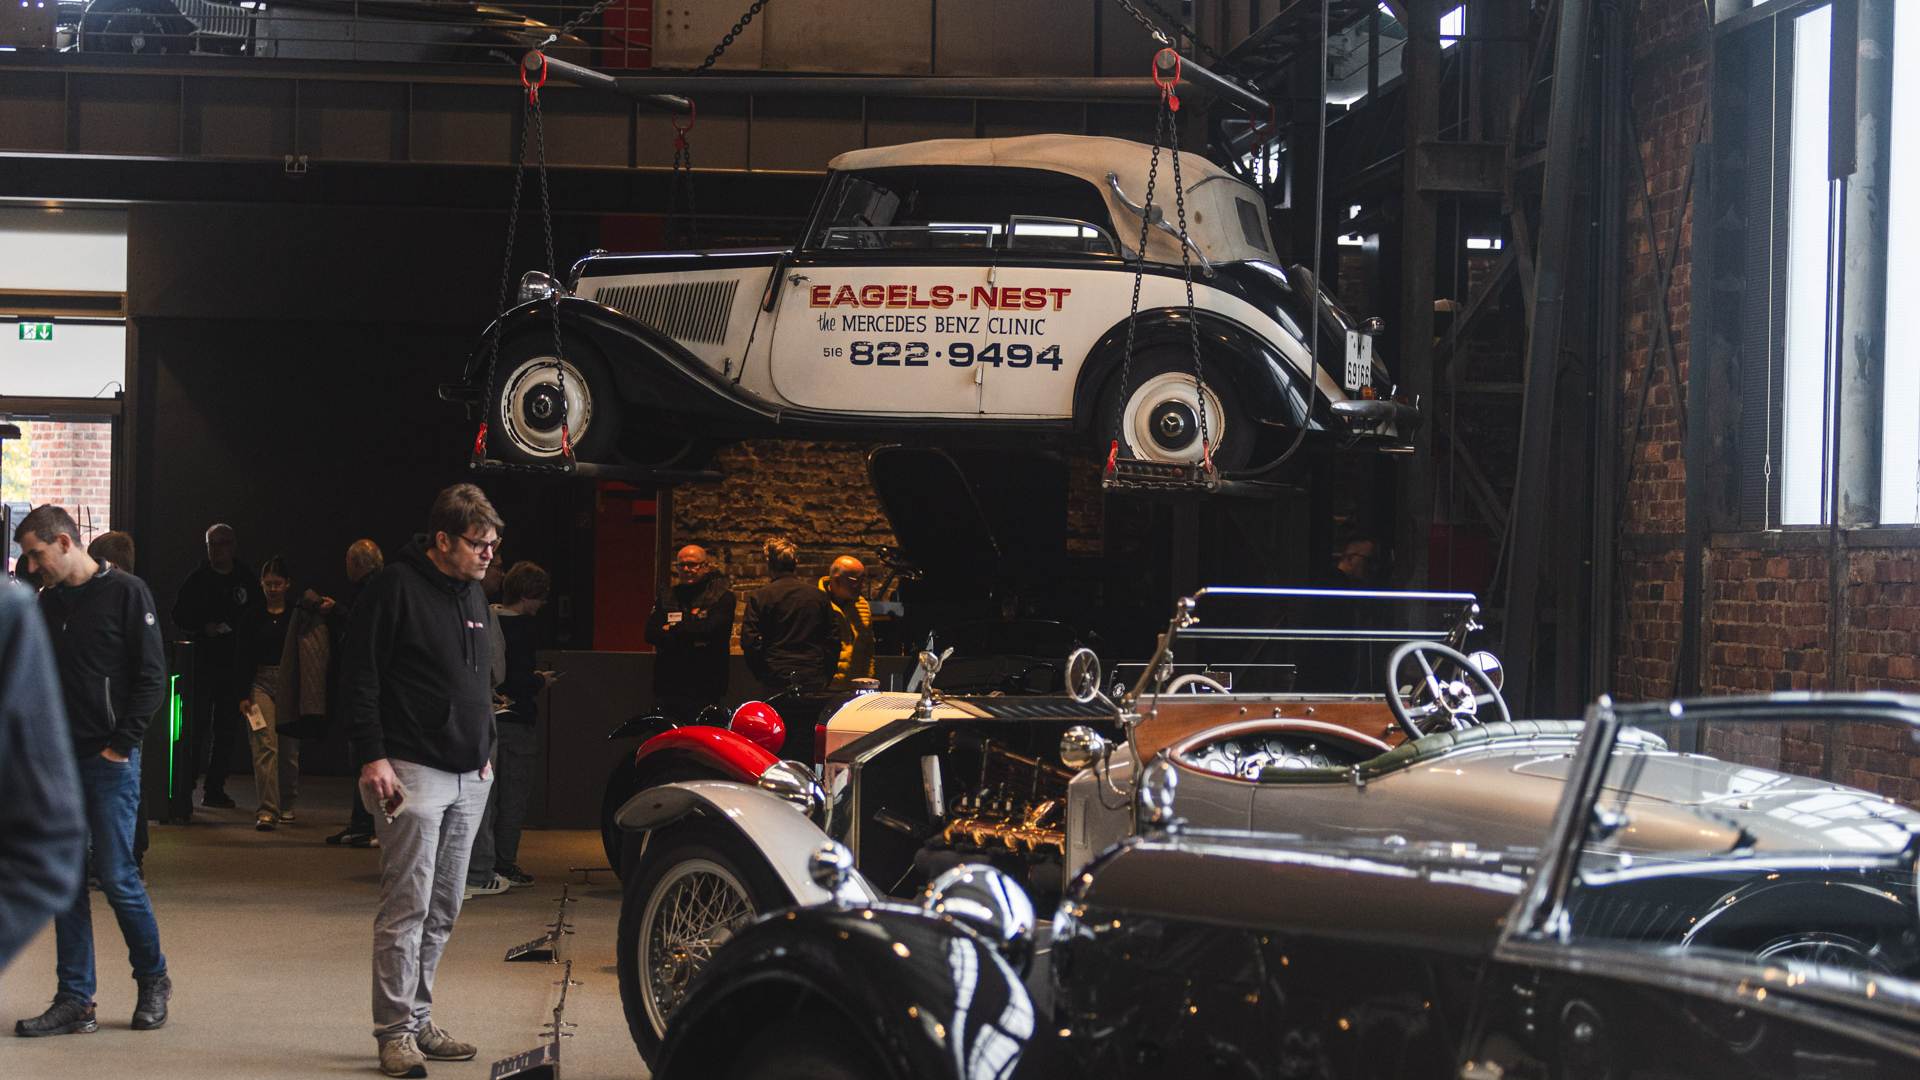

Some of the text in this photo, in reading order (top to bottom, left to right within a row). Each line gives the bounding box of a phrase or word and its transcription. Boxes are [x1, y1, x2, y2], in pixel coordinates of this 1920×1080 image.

[809, 285, 1072, 311] EAGELS-NEST
[816, 311, 1046, 335] the MERCEDES BENZ CLINIC
[823, 347, 843, 357] 516
